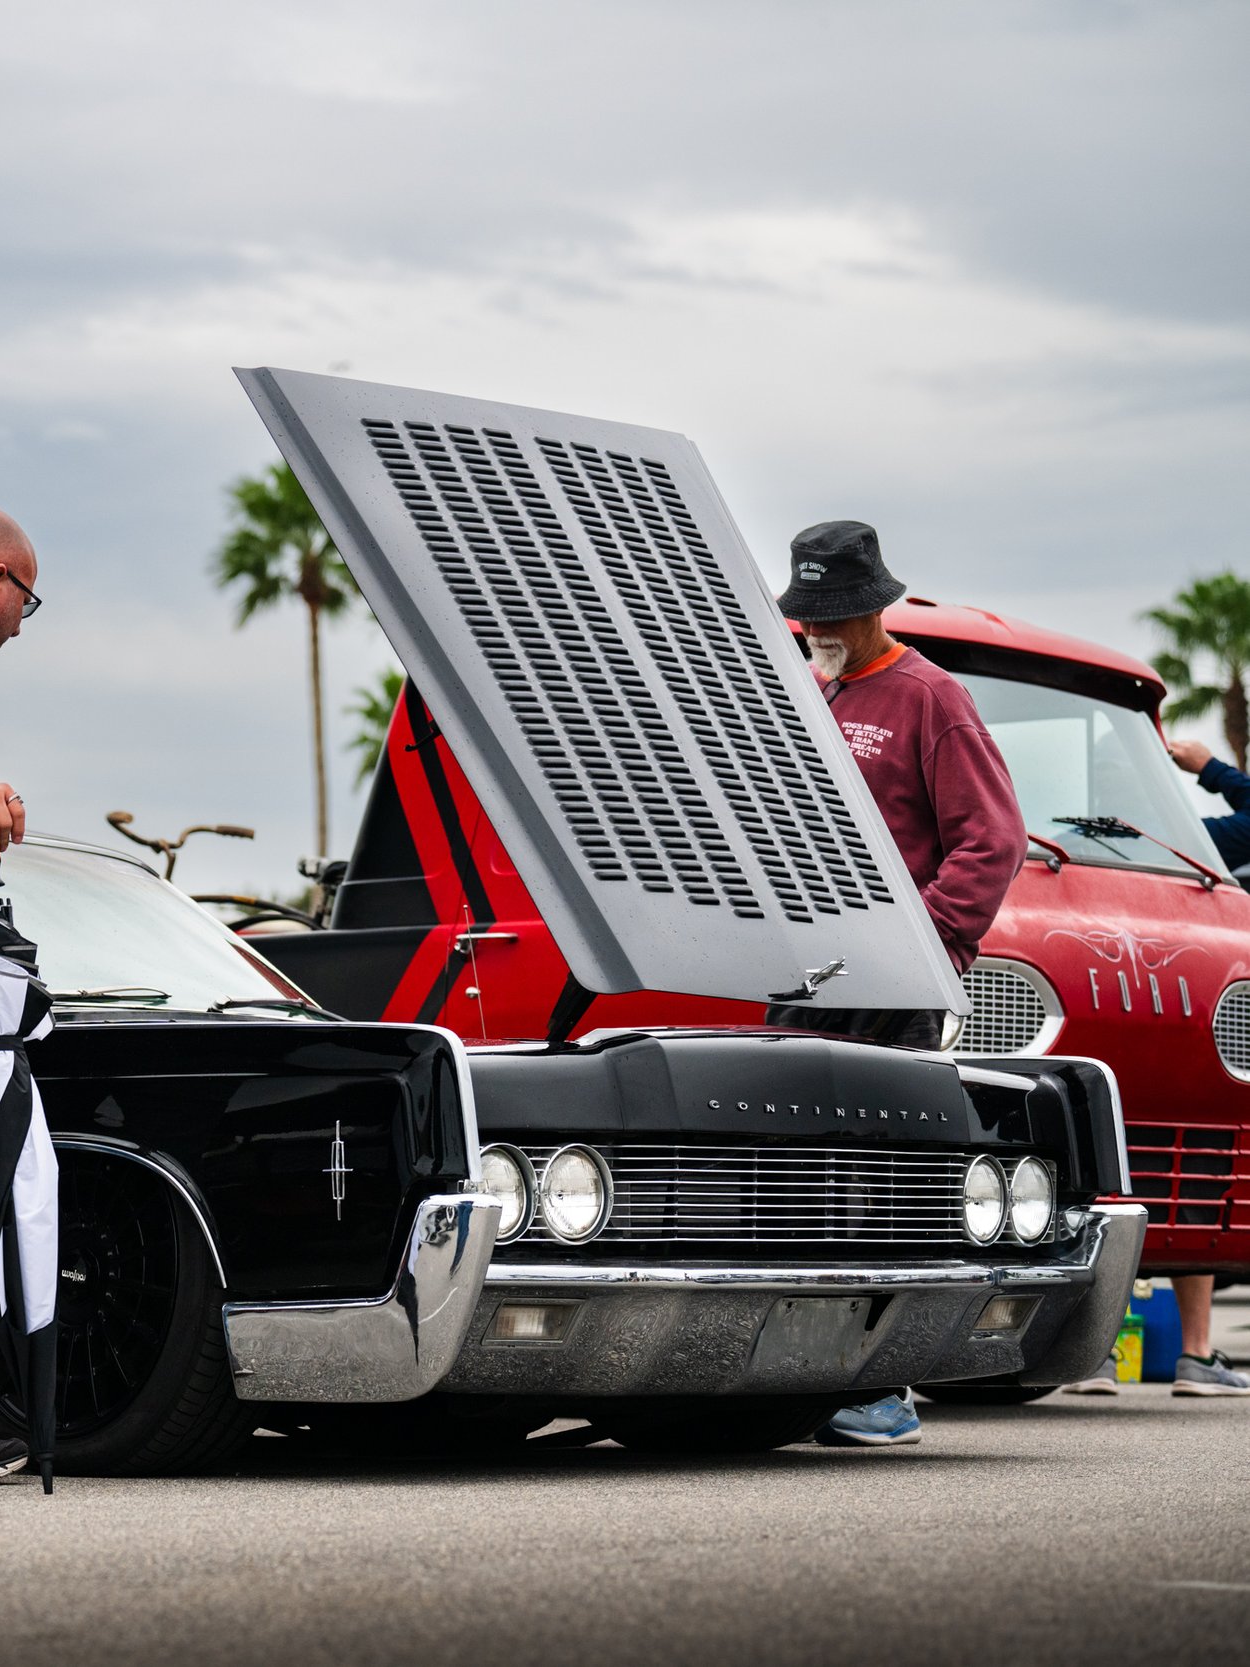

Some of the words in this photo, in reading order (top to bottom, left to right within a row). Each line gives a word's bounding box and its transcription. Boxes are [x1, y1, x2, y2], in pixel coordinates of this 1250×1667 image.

[853, 729, 885, 743] BETTER
[862, 723, 894, 738] BREATH
[852, 735, 874, 746] THAN
[850, 742, 882, 755] BREATH
[707, 1099, 948, 1122] CONTINENTAL
